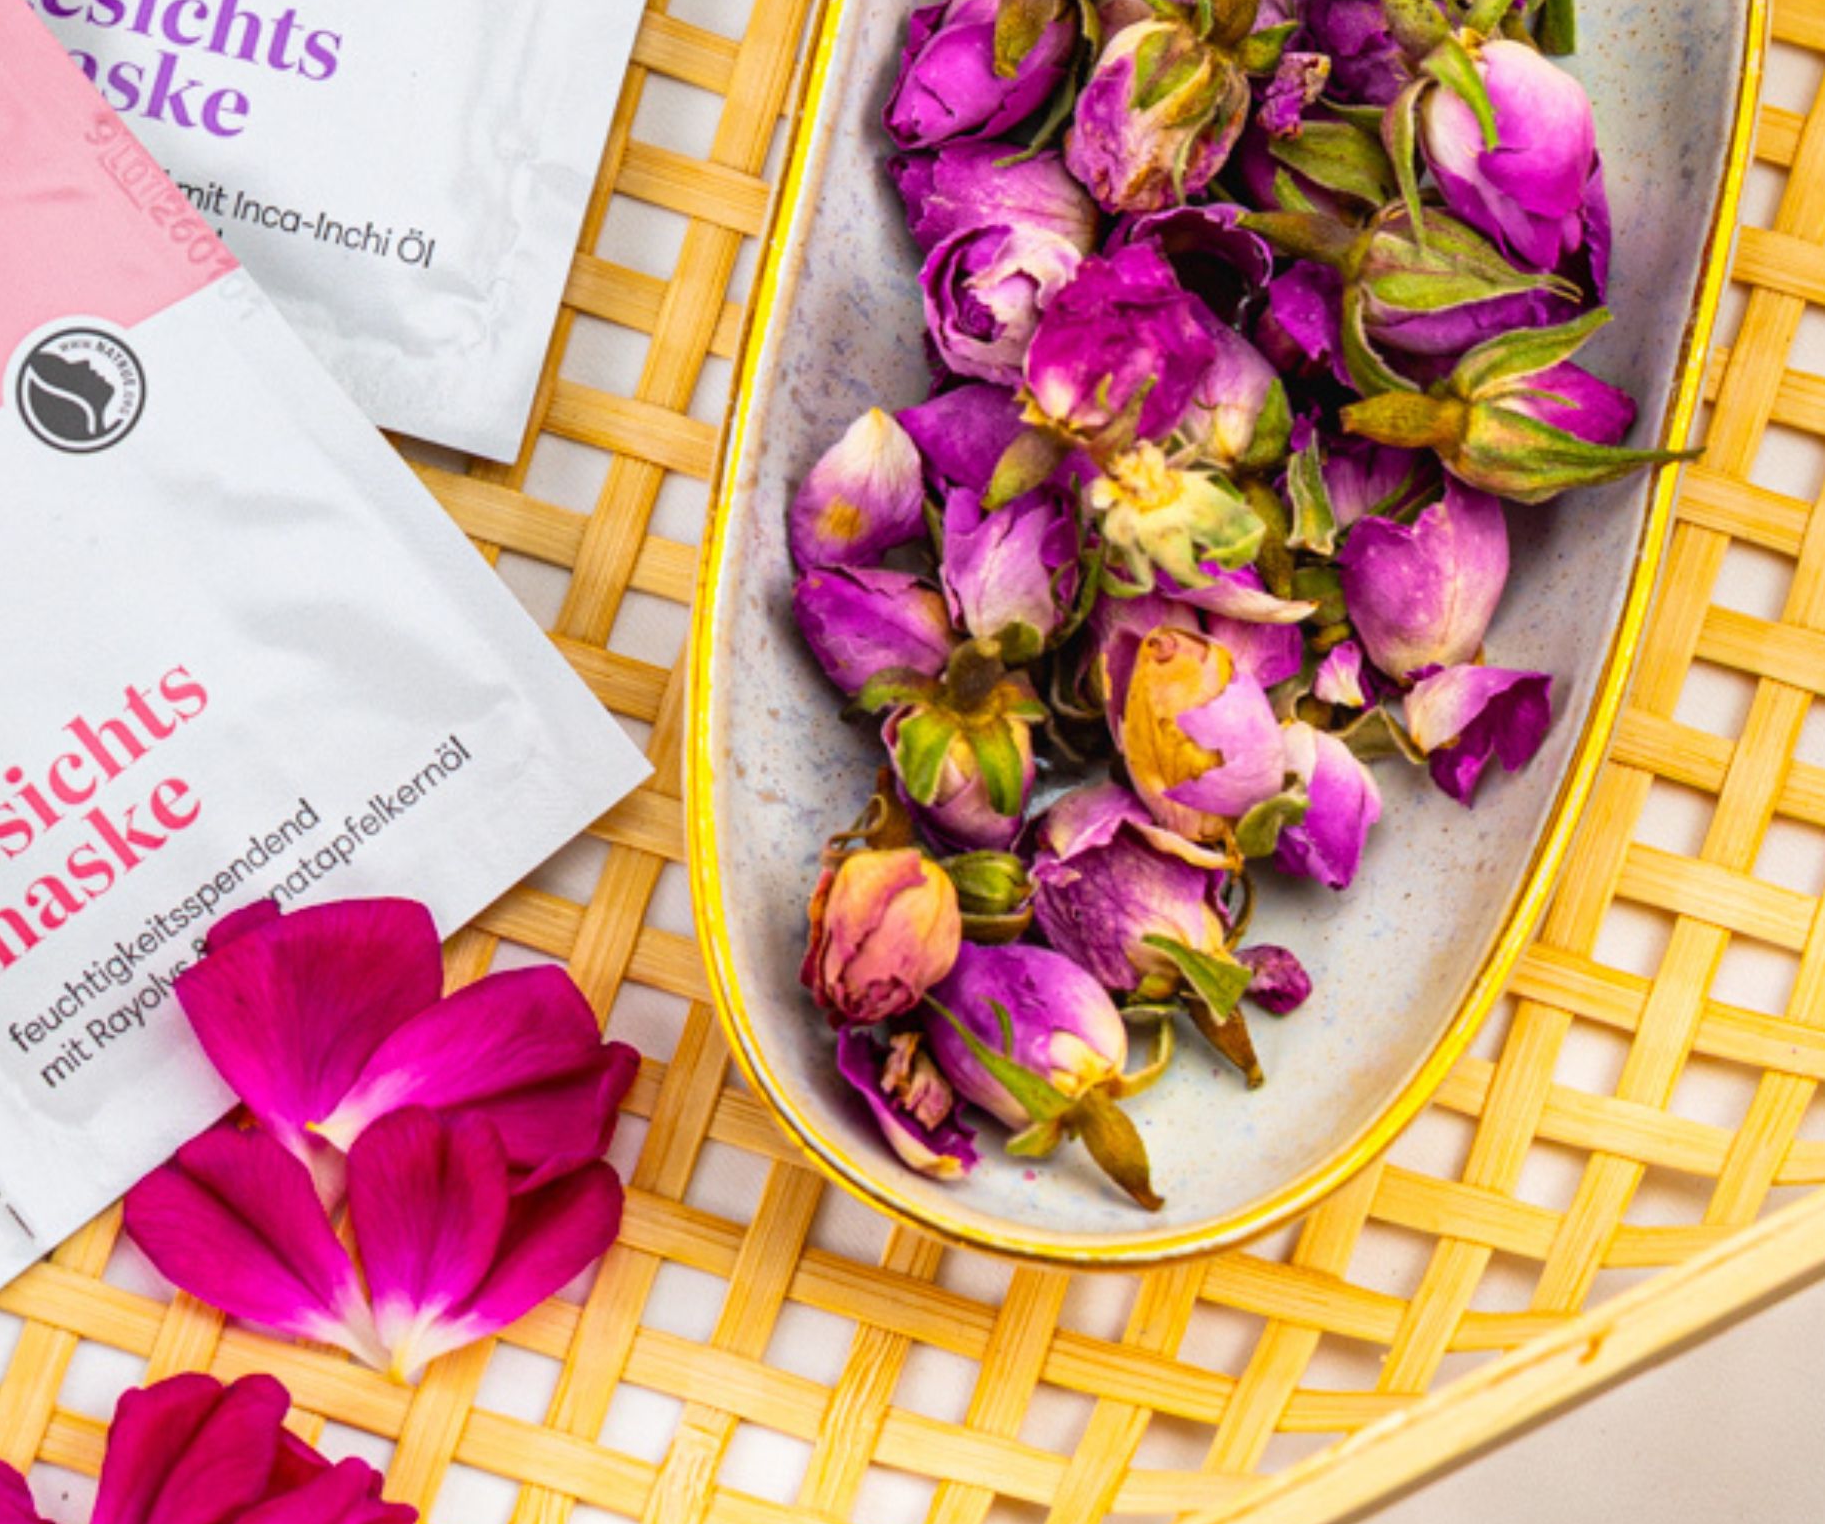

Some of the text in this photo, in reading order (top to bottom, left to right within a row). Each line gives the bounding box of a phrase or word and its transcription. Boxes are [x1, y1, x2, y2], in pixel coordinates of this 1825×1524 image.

[68, 49, 250, 138] ske
[233, 191, 393, 257] Inca-Inchi
[397, 233, 436, 269] Öl
[8, 797, 321, 1053] feuchtigkeitsspendend
[40, 1037, 94, 1089] mit
[266, 733, 472, 902] natapfelkernöl
